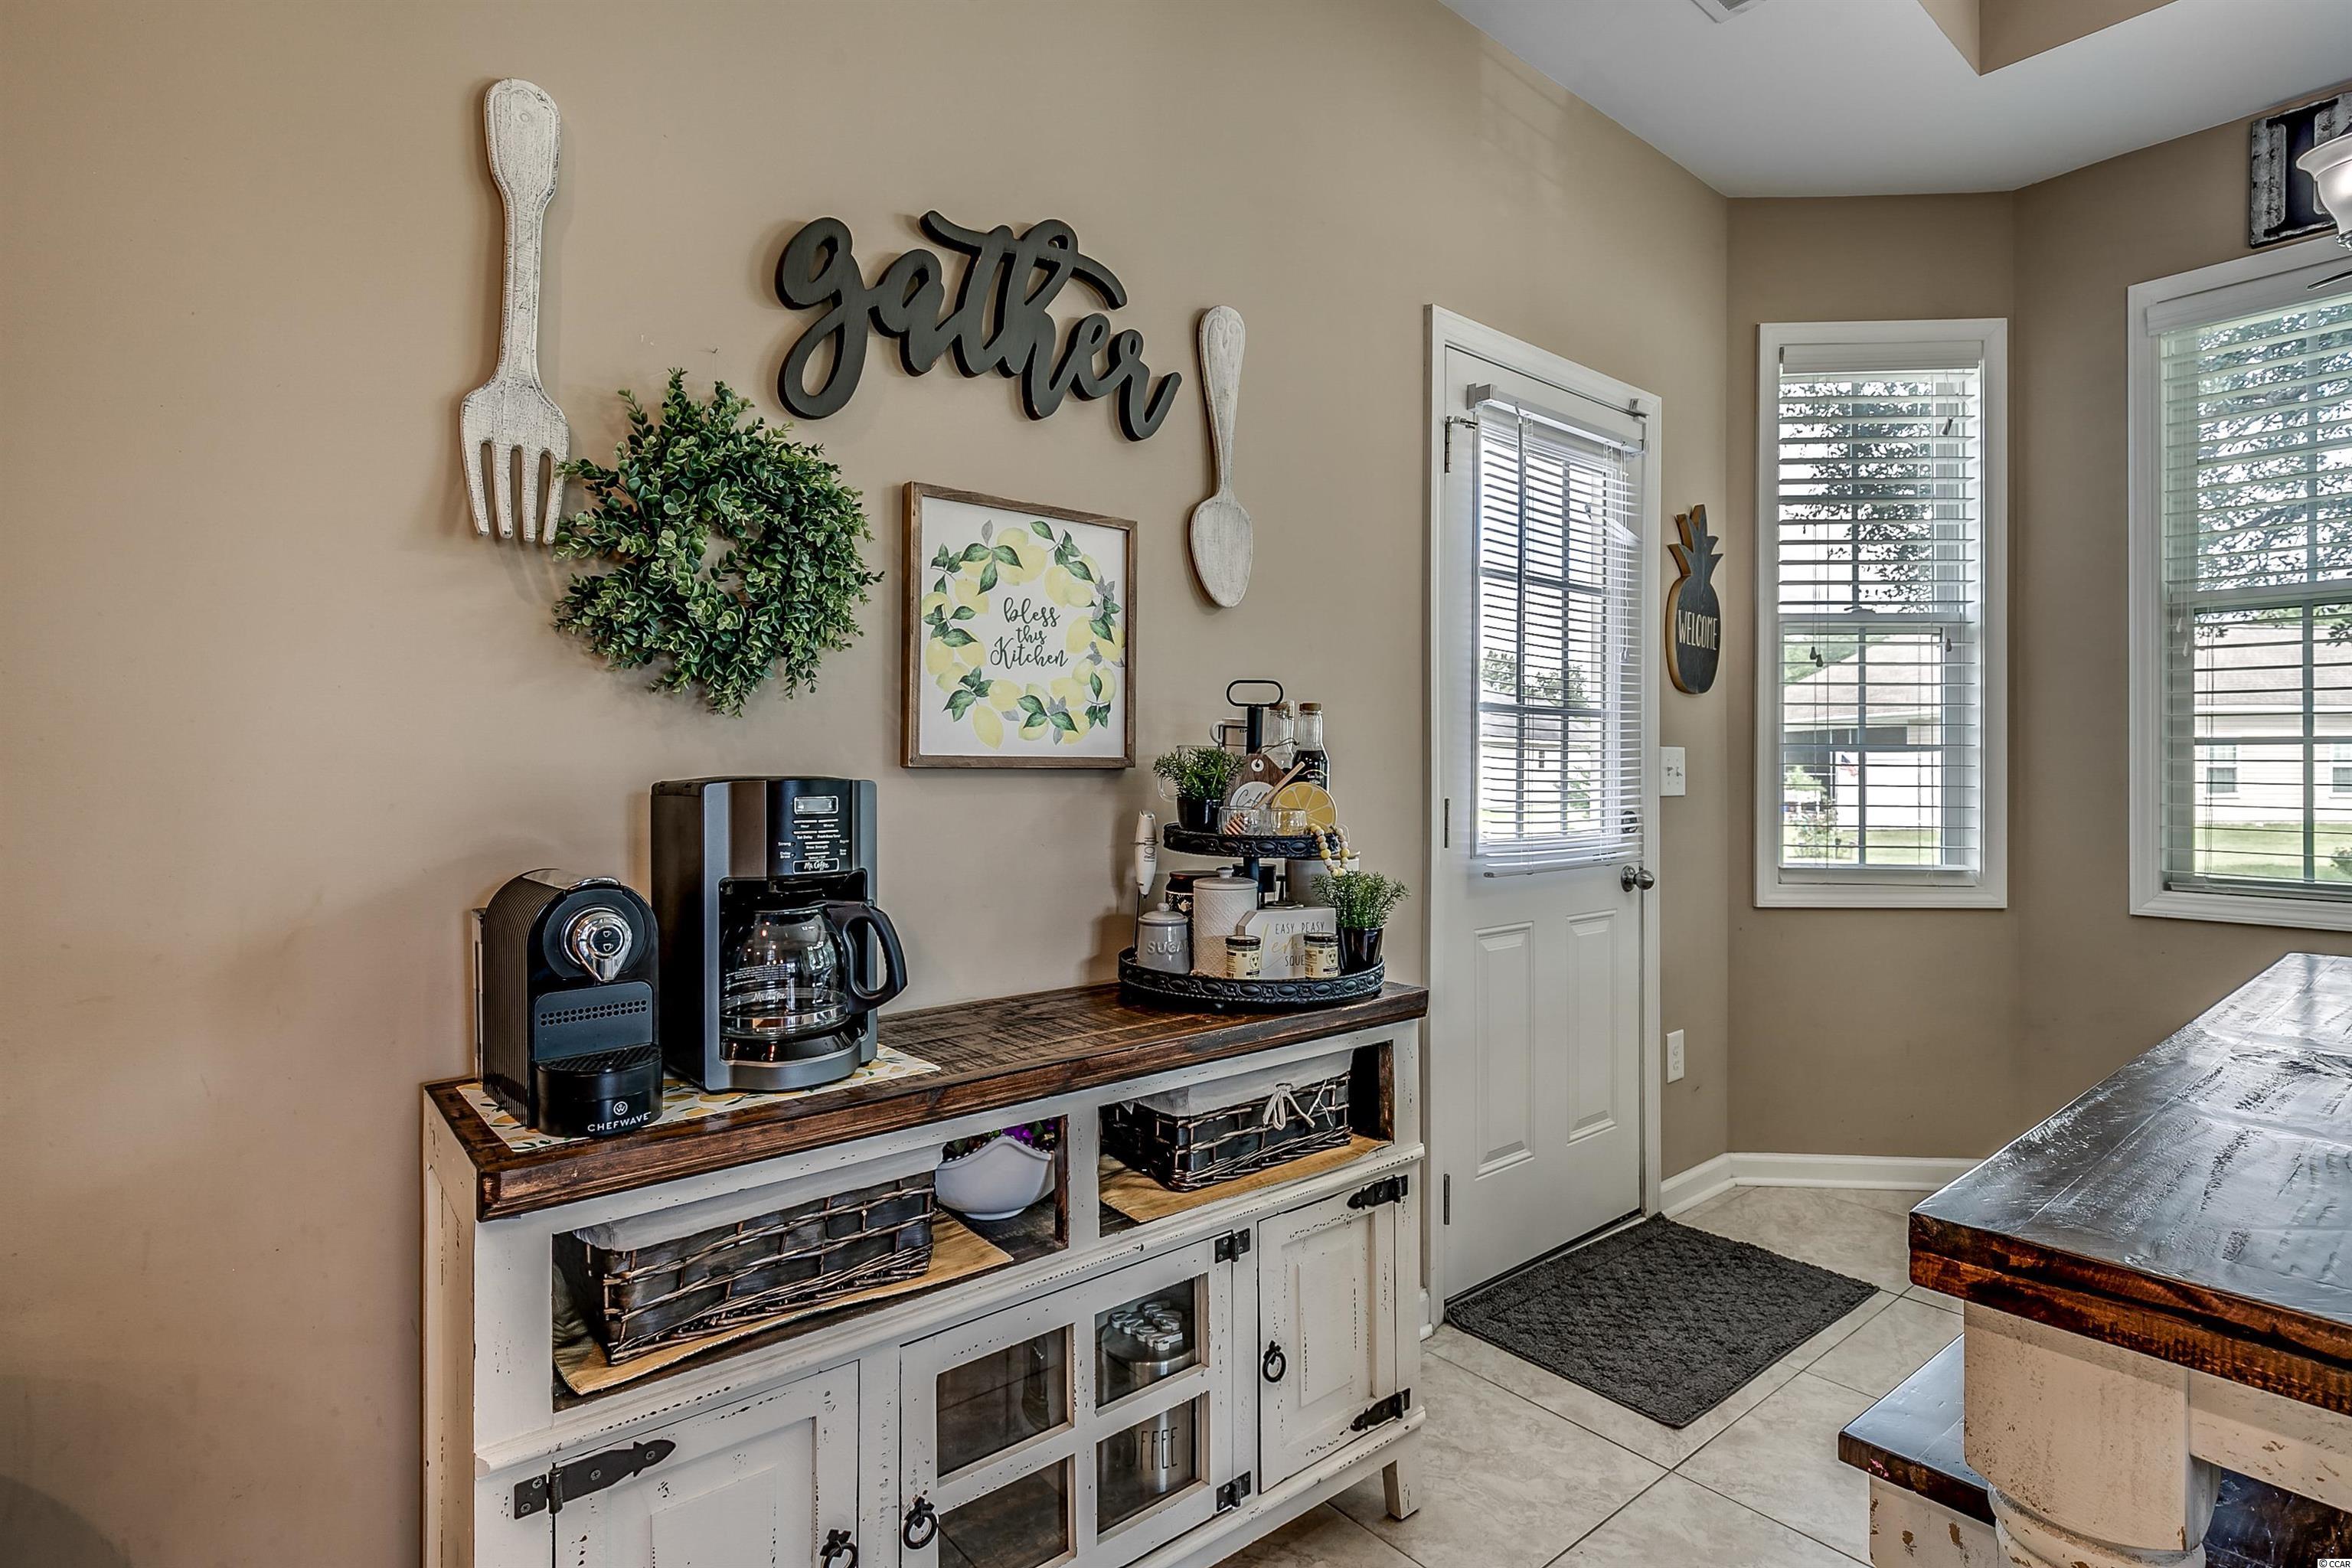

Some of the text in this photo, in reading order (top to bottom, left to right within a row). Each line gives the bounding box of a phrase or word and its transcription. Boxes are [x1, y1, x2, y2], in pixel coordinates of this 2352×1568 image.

[775, 210, 1183, 443] gather
[1004, 596, 1060, 627] bless
[1015, 625, 1047, 645] this
[1678, 609, 1718, 651] WELCOME
[990, 636, 1069, 669] Kitchen
[1275, 921, 1325, 935] EASY PEASY
[1285, 955, 1305, 967] SQUE
[586, 1111, 652, 1132] CHEFWAVE
